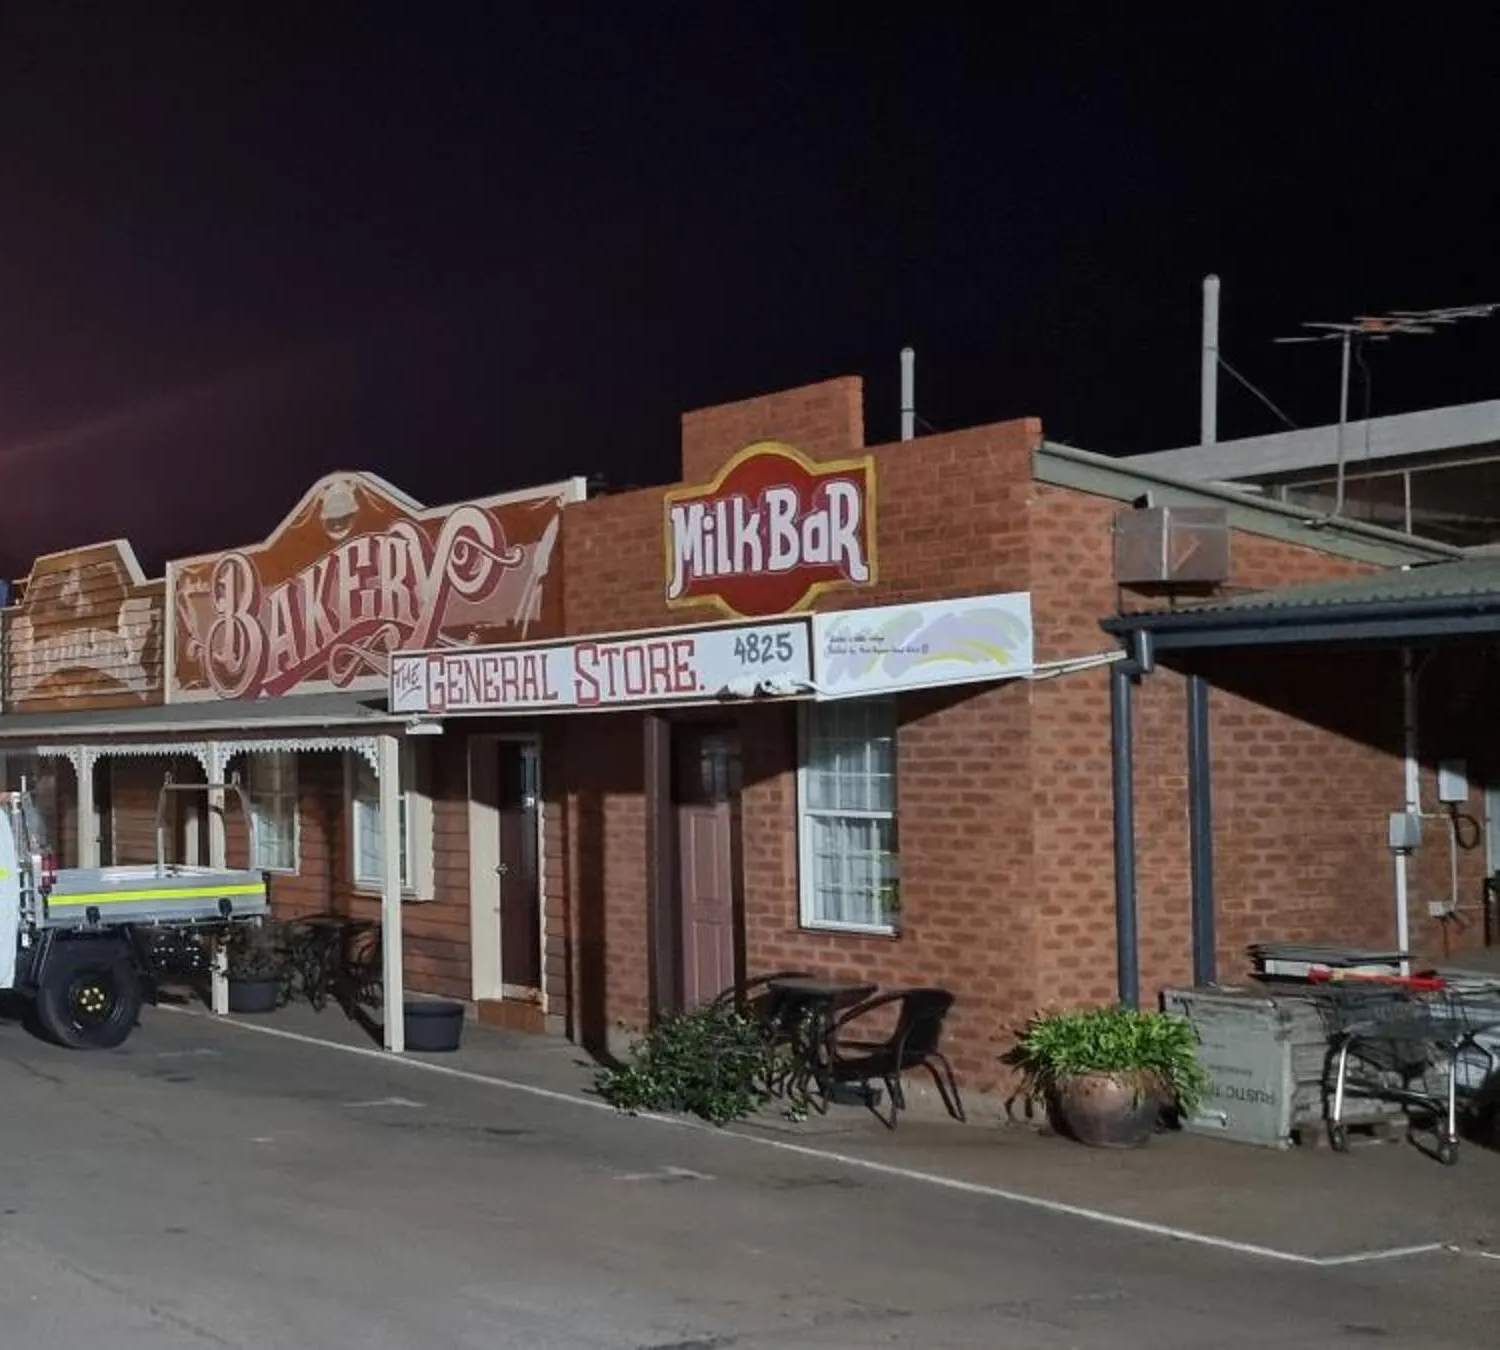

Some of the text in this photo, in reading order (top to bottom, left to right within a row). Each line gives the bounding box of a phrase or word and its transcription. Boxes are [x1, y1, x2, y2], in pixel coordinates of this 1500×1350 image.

[206, 504, 523, 699] BAKERY
[733, 630, 794, 666] 4825
[394, 662, 421, 691] THE
[426, 653, 559, 714] GENERAL
